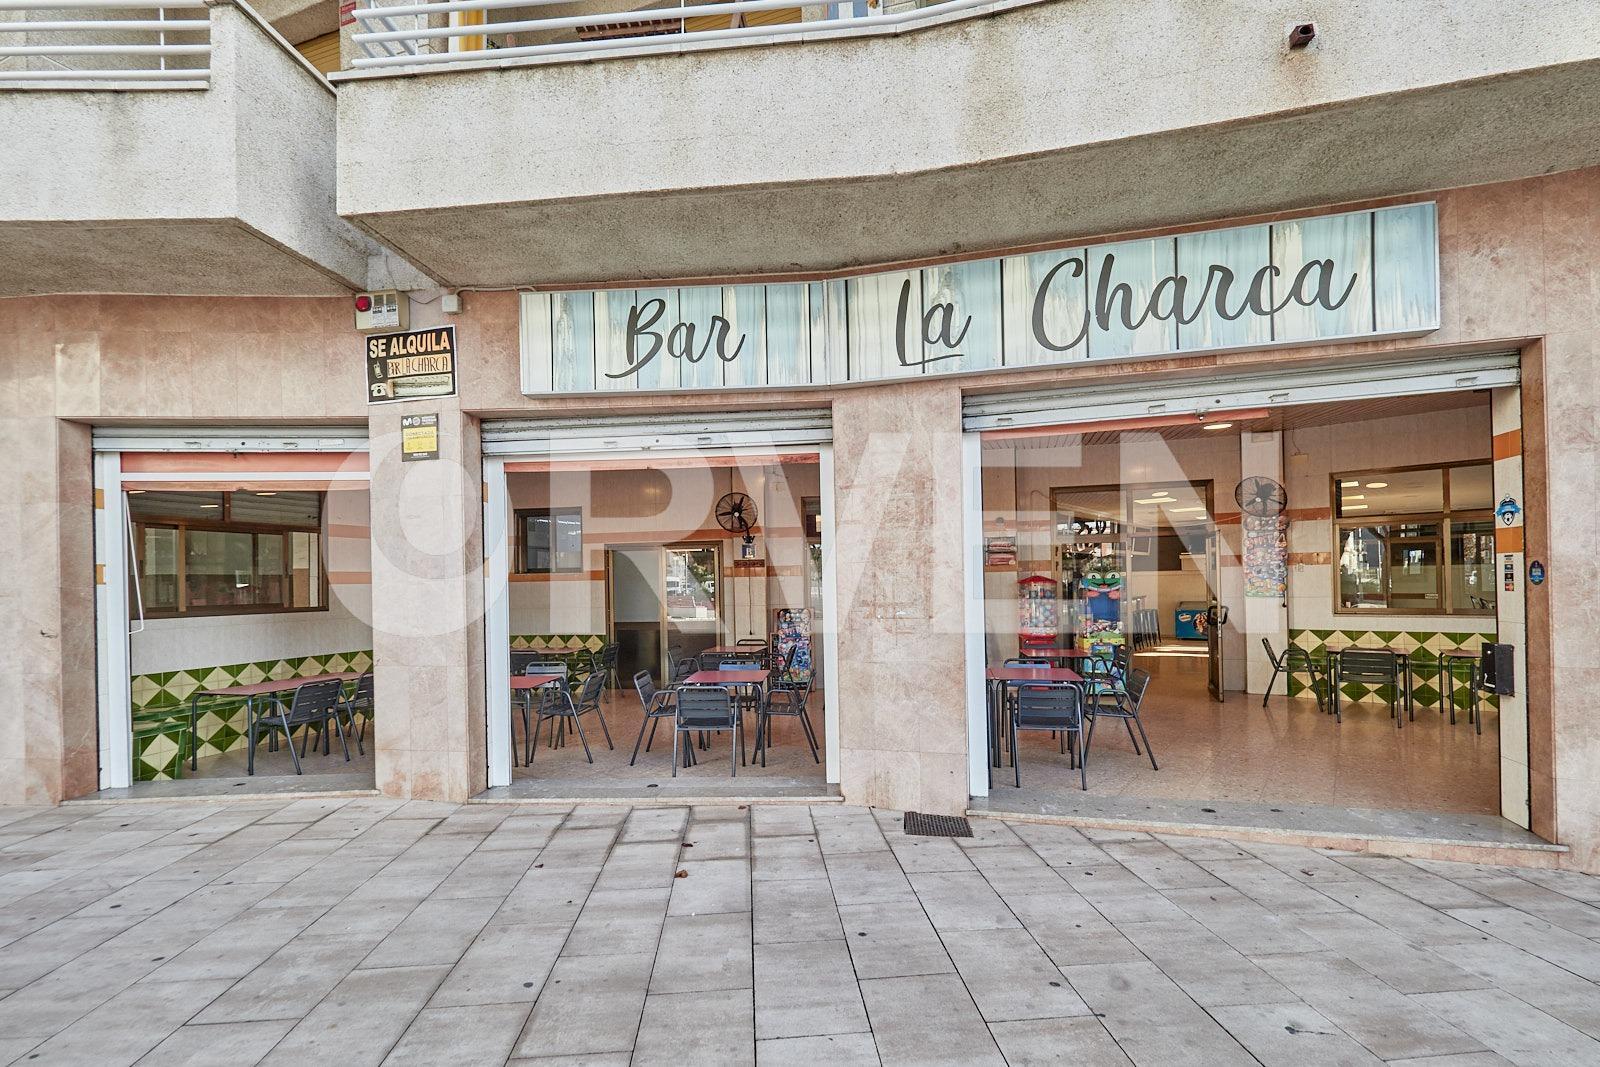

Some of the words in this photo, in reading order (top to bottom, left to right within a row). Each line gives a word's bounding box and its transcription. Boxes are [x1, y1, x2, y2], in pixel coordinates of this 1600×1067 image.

[605, 298, 746, 379] Bar
[895, 278, 972, 367] La
[1031, 252, 1358, 352] Charca
[369, 338, 387, 359] SE
[389, 331, 451, 356] ALQUILA
[387, 360, 402, 377] BAR
